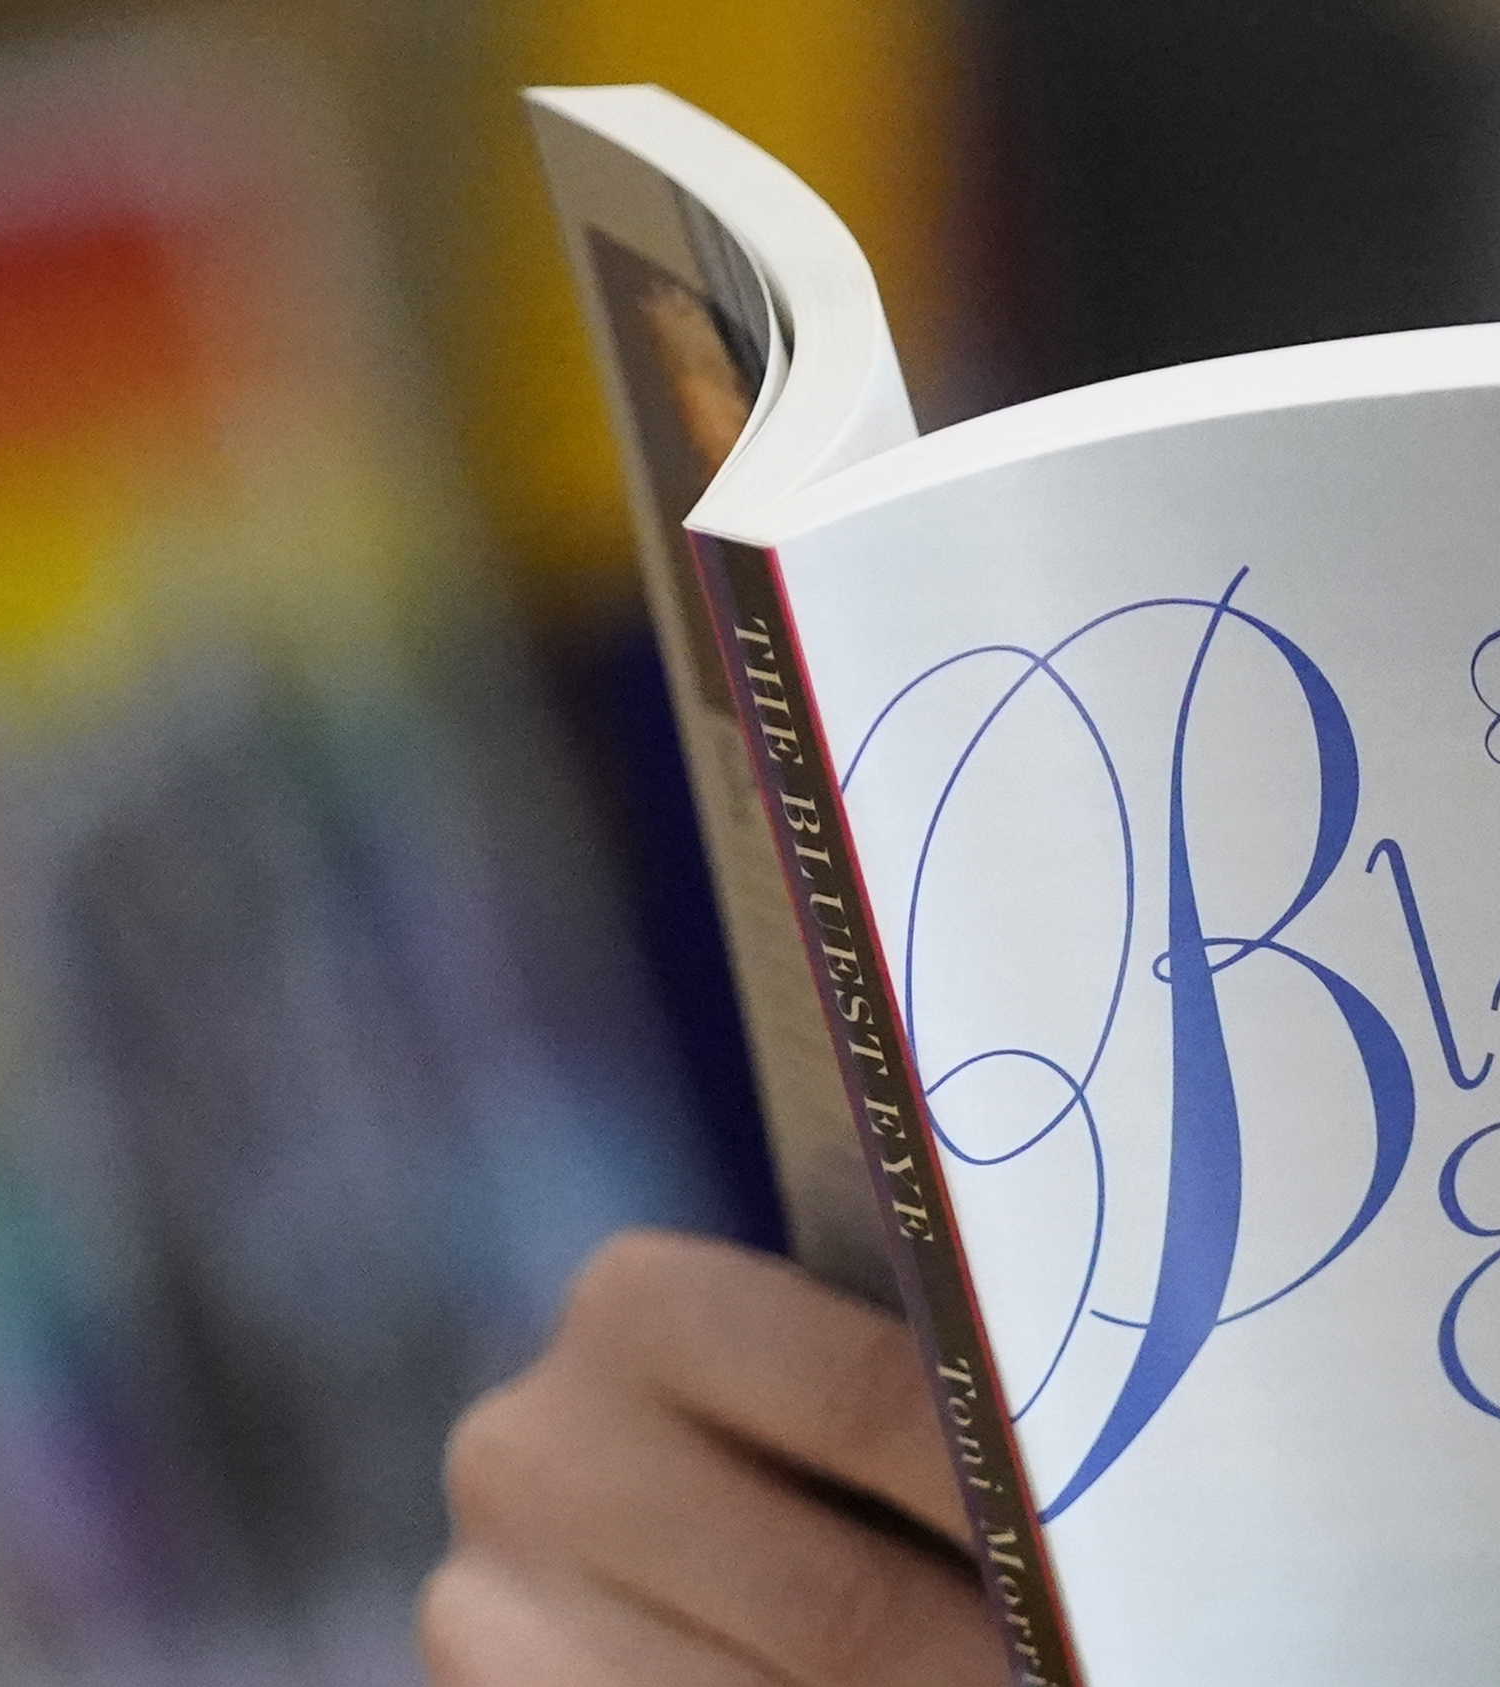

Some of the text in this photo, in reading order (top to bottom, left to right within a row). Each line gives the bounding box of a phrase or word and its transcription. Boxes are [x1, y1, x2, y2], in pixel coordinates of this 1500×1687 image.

[733, 616, 934, 1243] THE BLUEST EYE
[938, 1356, 1004, 1492] Toni
